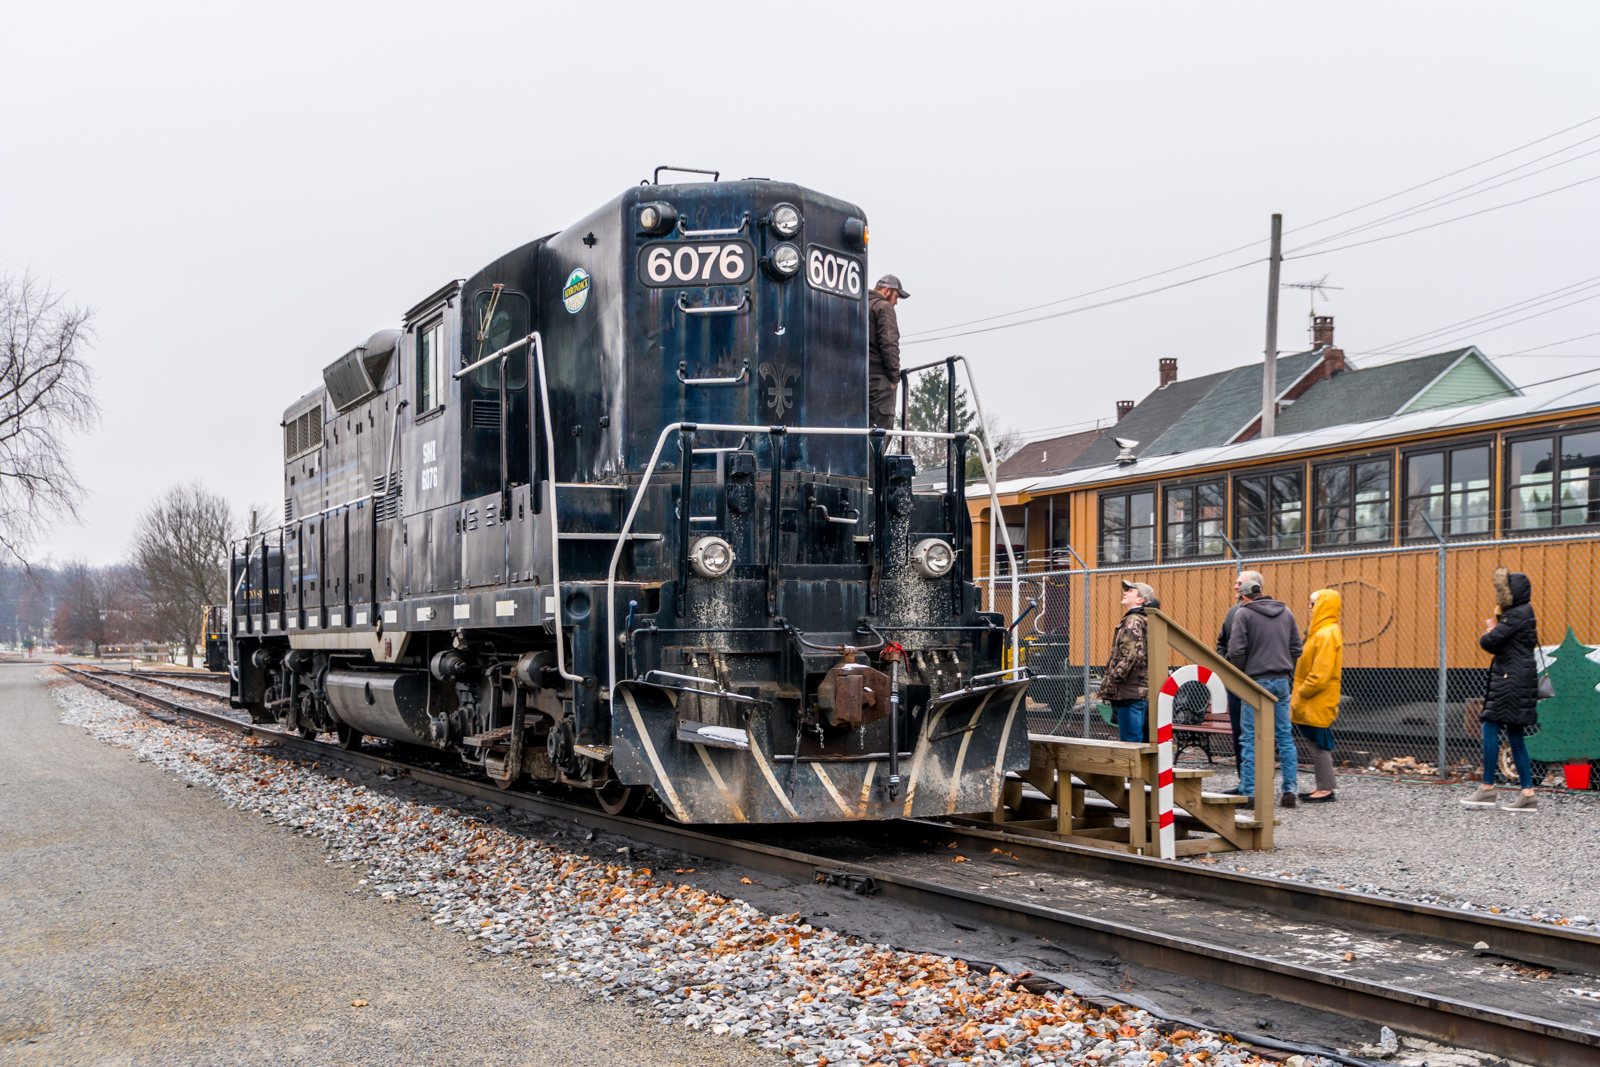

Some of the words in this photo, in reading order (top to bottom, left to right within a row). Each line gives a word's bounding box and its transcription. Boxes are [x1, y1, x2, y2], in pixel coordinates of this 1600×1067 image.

[647, 244, 745, 282] 6076
[809, 249, 860, 294] 6076
[422, 466, 437, 490] 6076
